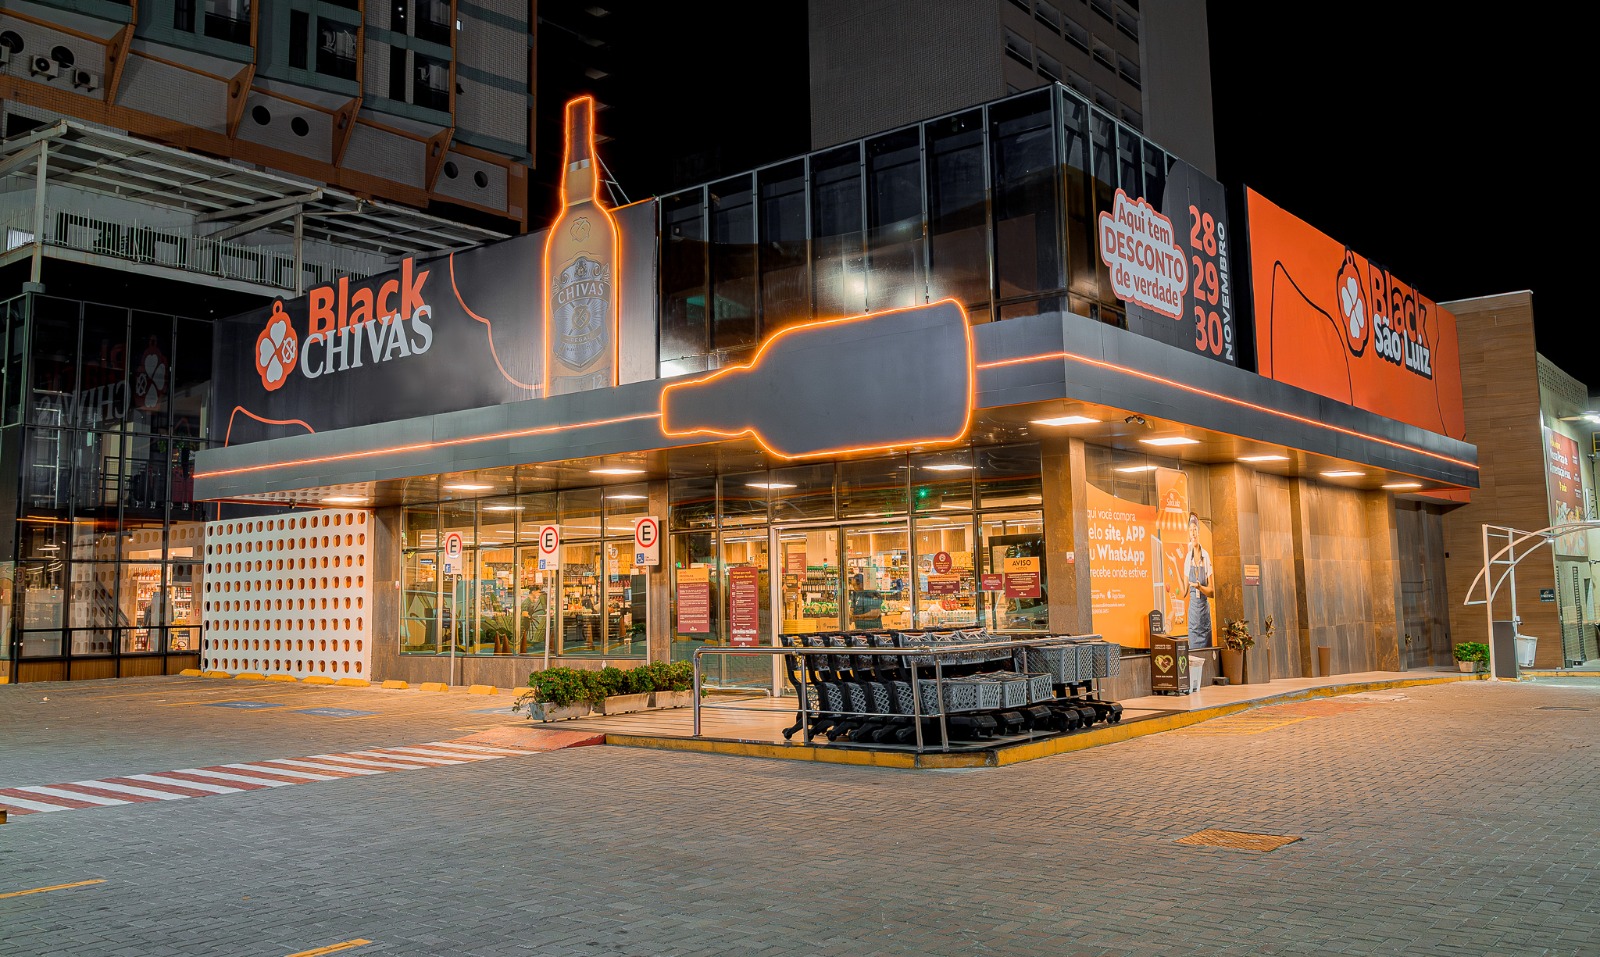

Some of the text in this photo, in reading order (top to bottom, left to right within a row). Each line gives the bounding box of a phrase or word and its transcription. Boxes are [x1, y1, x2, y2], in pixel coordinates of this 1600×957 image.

[1117, 202, 1170, 245] Aqui tem
[1189, 205, 1217, 257] 28
[1105, 226, 1184, 284] DESCONTO
[308, 257, 431, 343] Black
[558, 282, 604, 304] CHIVAS
[1115, 265, 1179, 308] de verdade
[1191, 255, 1220, 306] 29
[1217, 222, 1234, 361] NOVEMBRO
[1371, 264, 1428, 347] Black
[300, 304, 433, 379] CHIVAS
[1194, 305, 1224, 356] 30
[1374, 314, 1432, 375] São Luiz
[642, 525, 651, 541] E
[1087, 507, 1136, 523] qui você compra
[1088, 523, 1146, 545] elo site, APP
[450, 539, 457, 553] E
[545, 533, 553, 548] E
[1096, 543, 1145, 565] WhatsApp
[1112, 566, 1128, 578] onde
